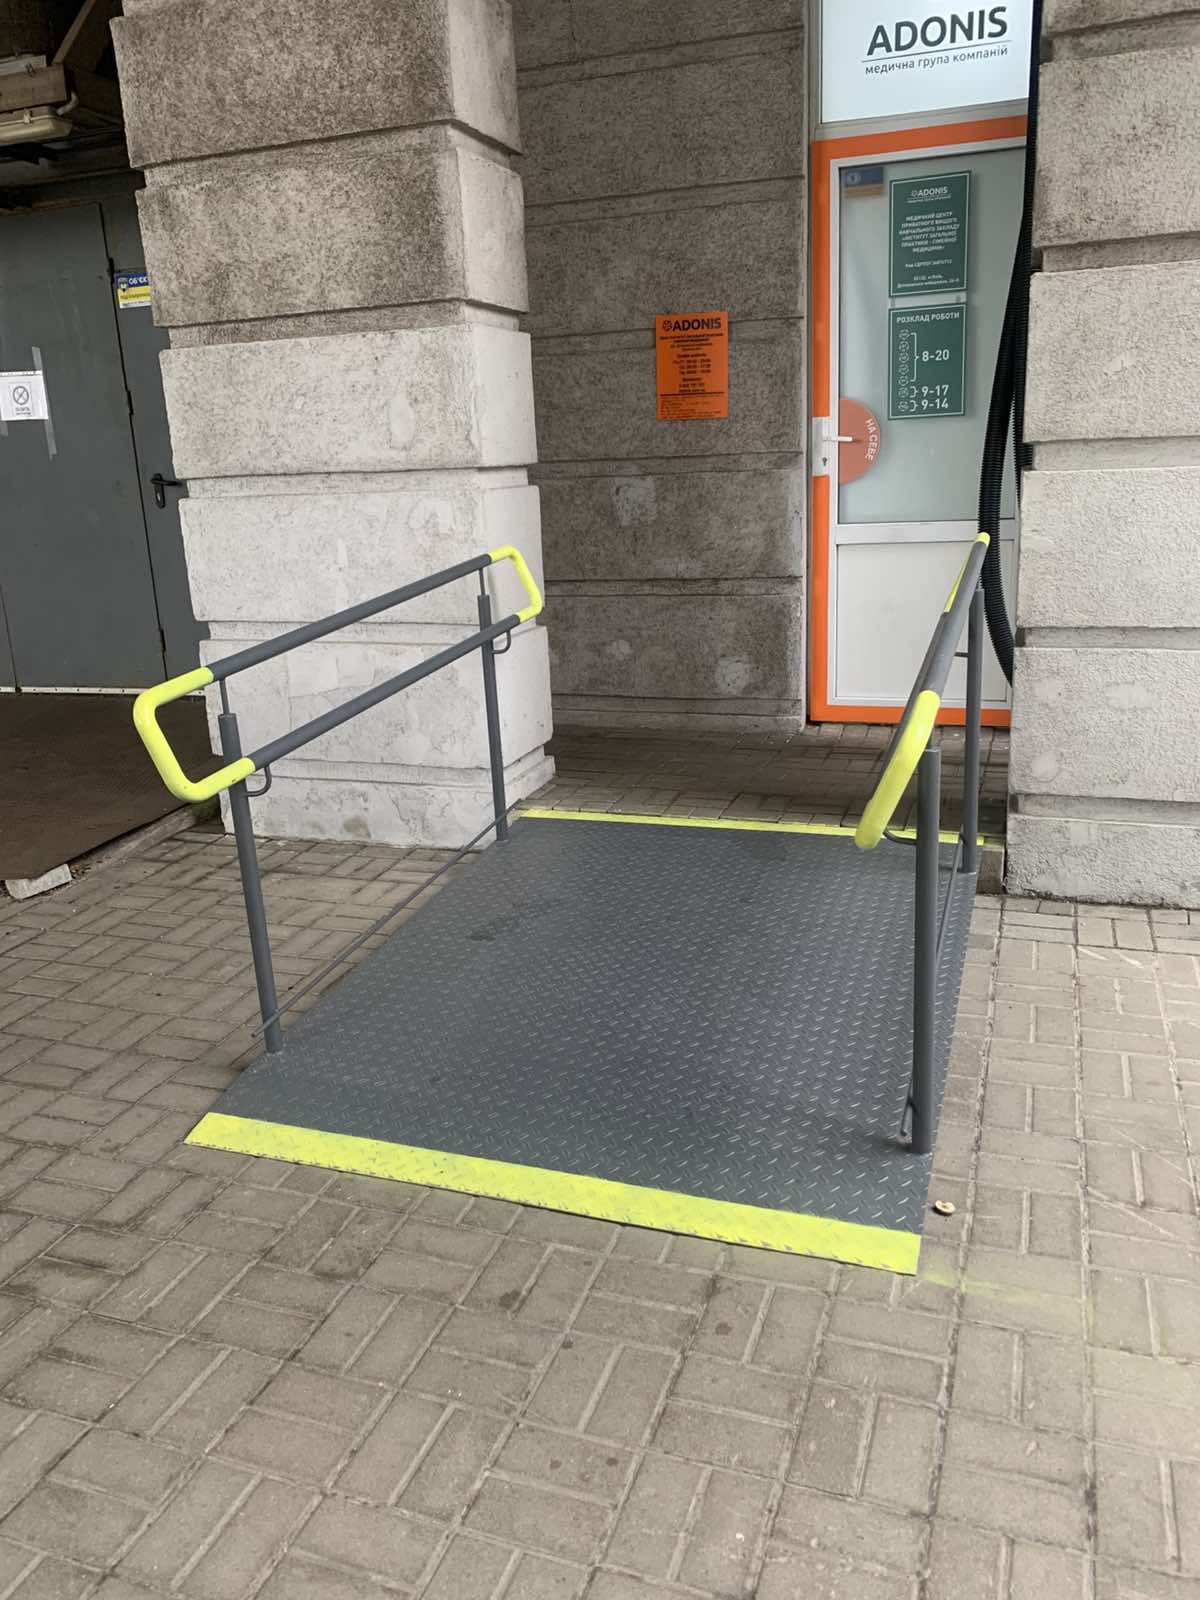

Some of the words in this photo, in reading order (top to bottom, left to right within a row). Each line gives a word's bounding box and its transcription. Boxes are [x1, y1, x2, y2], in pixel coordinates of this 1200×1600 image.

[867, 6, 1007, 56] ADONIS
[865, 58, 915, 74] медична
[918, 54, 950, 69] група
[953, 45, 1008, 62] компаній
[917, 186, 948, 197] ADONIS
[673, 317, 721, 332] ADONIS
[896, 314, 930, 323] РОЗКЛАД
[931, 312, 960, 320] РОБОТИ
[922, 349, 949, 362] 8-20
[921, 384, 949, 397] 9-17
[921, 398, 949, 410] 9-14
[865, 418, 877, 434] НА
[866, 434, 878, 461] СЕБЕ
